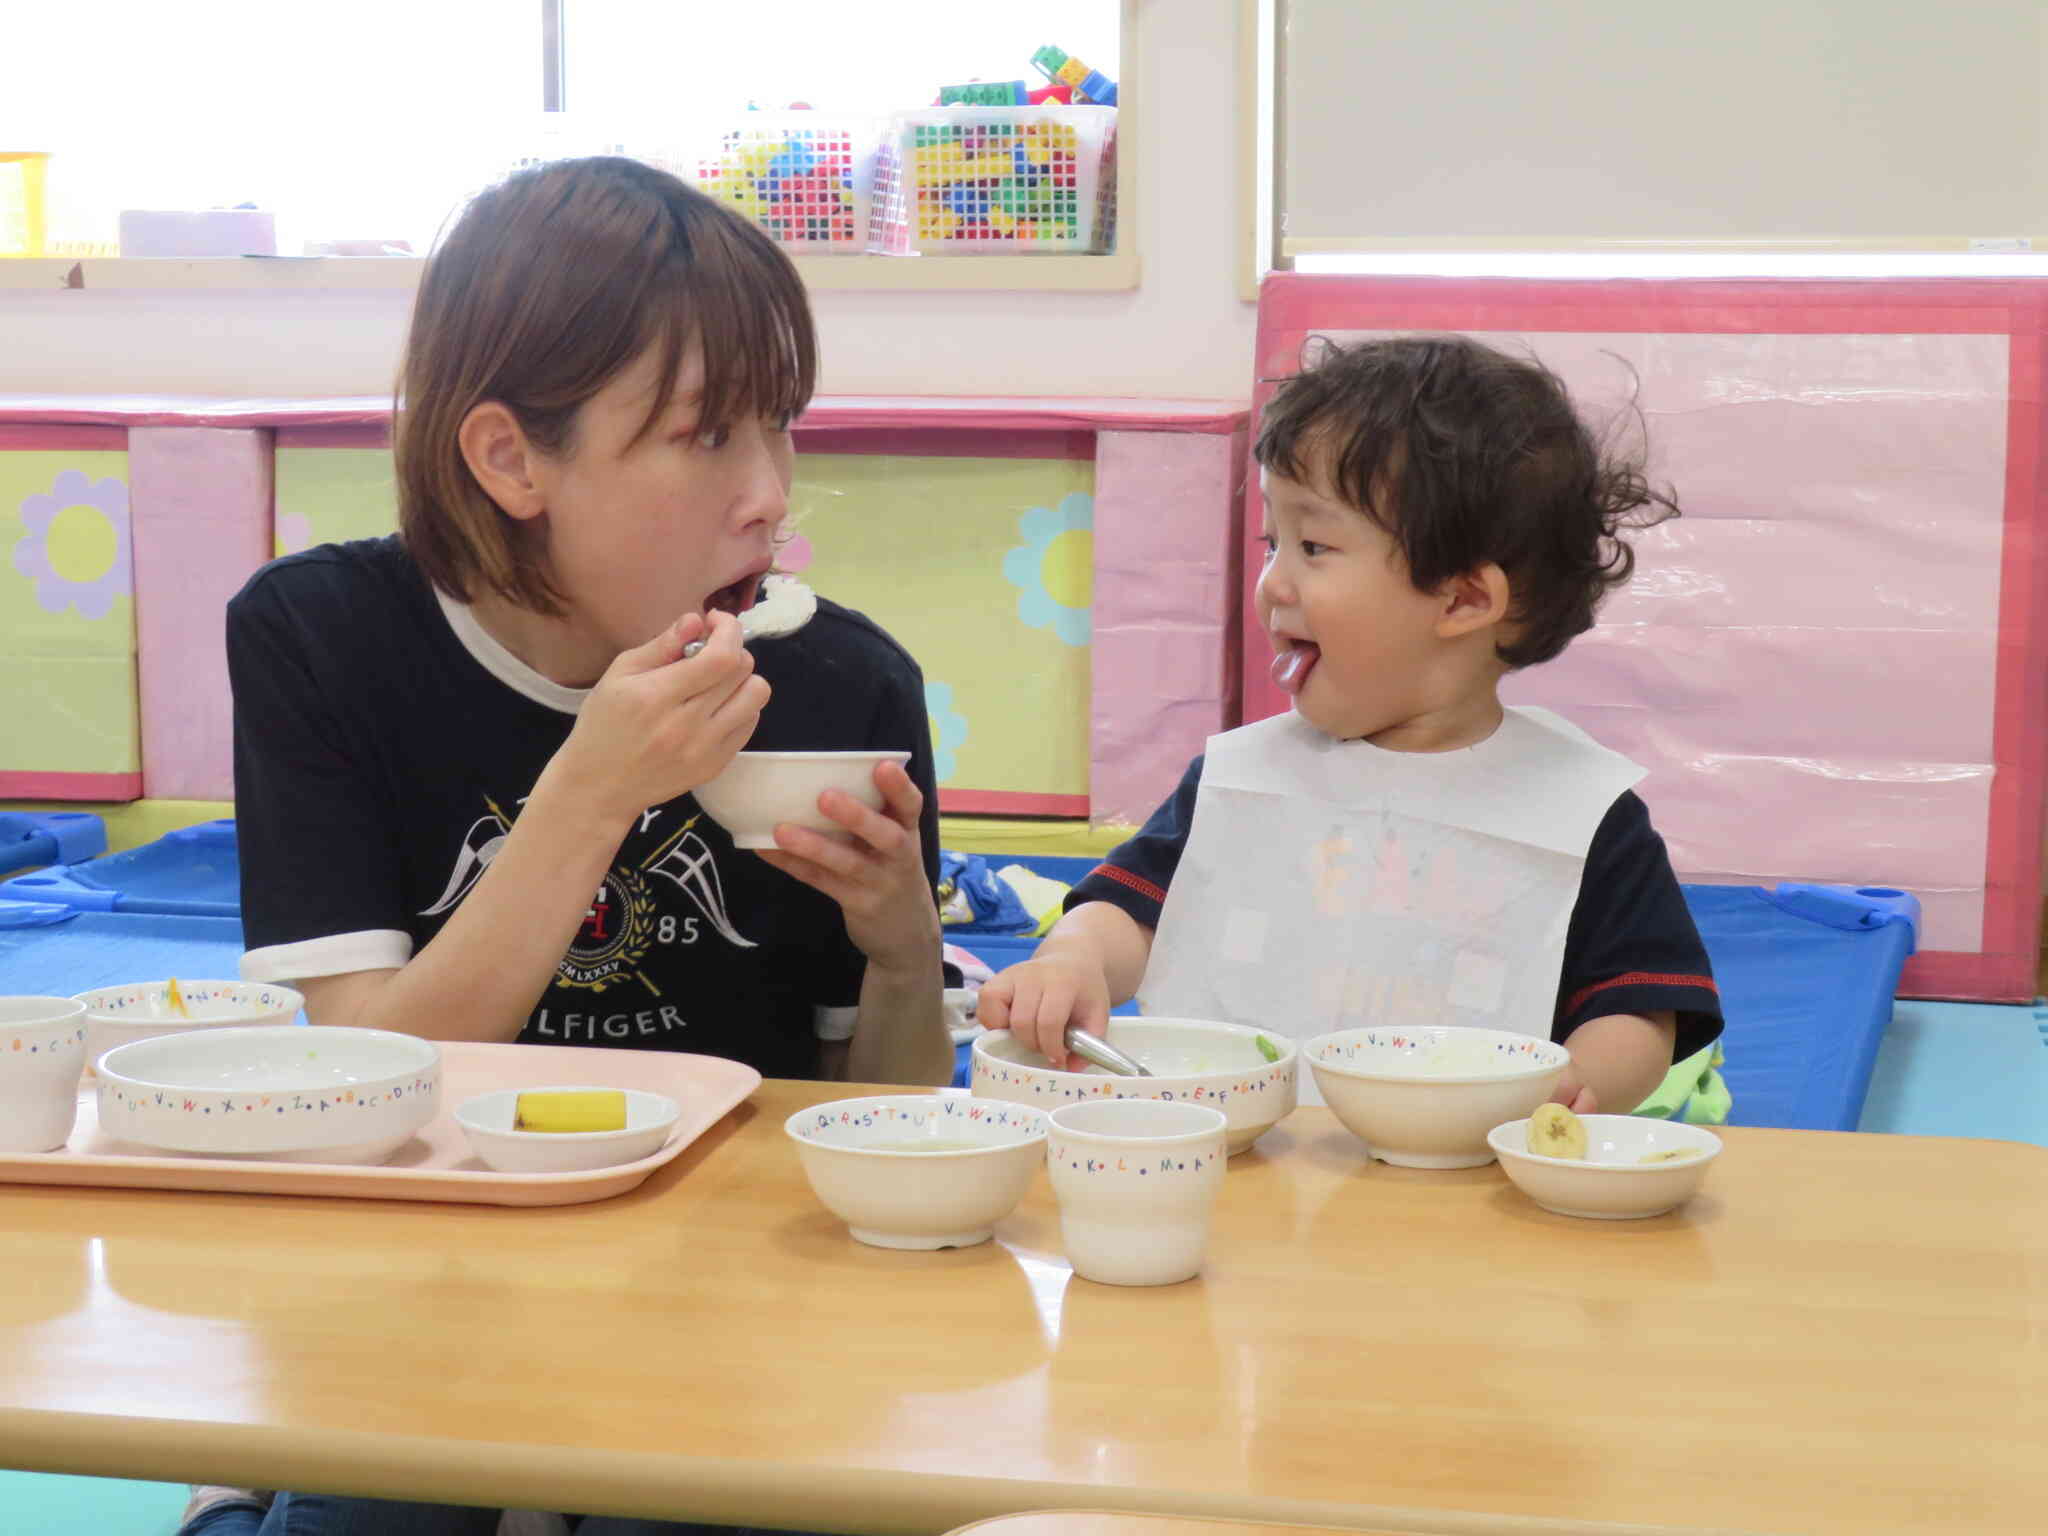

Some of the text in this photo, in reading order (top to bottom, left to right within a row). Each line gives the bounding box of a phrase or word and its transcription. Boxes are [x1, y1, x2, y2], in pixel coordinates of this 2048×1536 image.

[657, 915, 699, 943] 85
[536, 1005, 687, 1040] LFIGER
[1194, 1087, 1206, 1100] E
